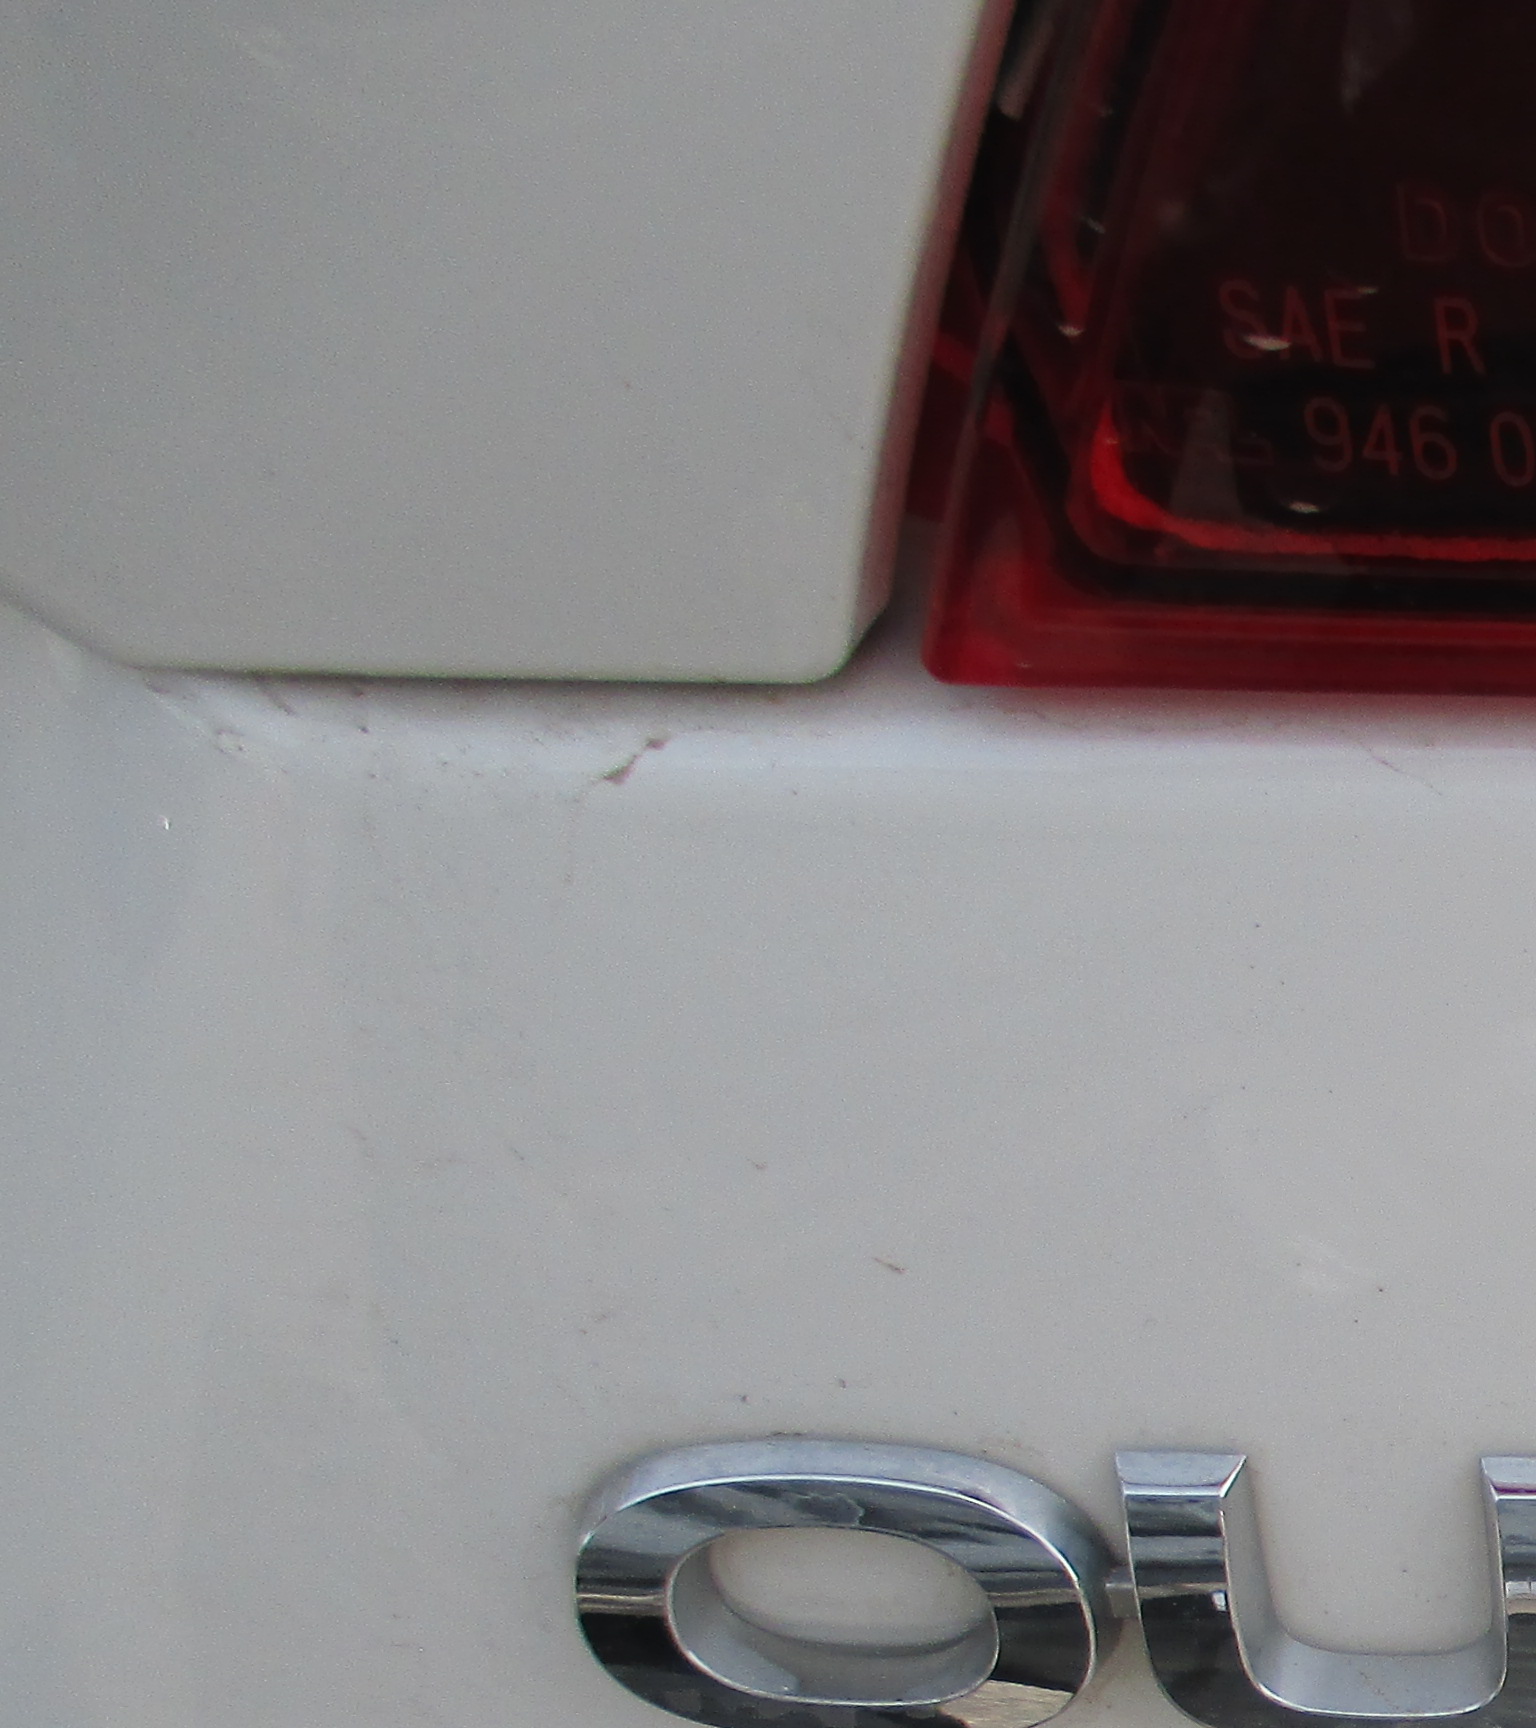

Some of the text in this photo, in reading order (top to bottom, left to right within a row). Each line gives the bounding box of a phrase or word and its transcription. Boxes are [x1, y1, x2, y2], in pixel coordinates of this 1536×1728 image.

[1218, 278, 1376, 371] SAE
[1432, 294, 1488, 376] R
[1303, 396, 1459, 481] 946
